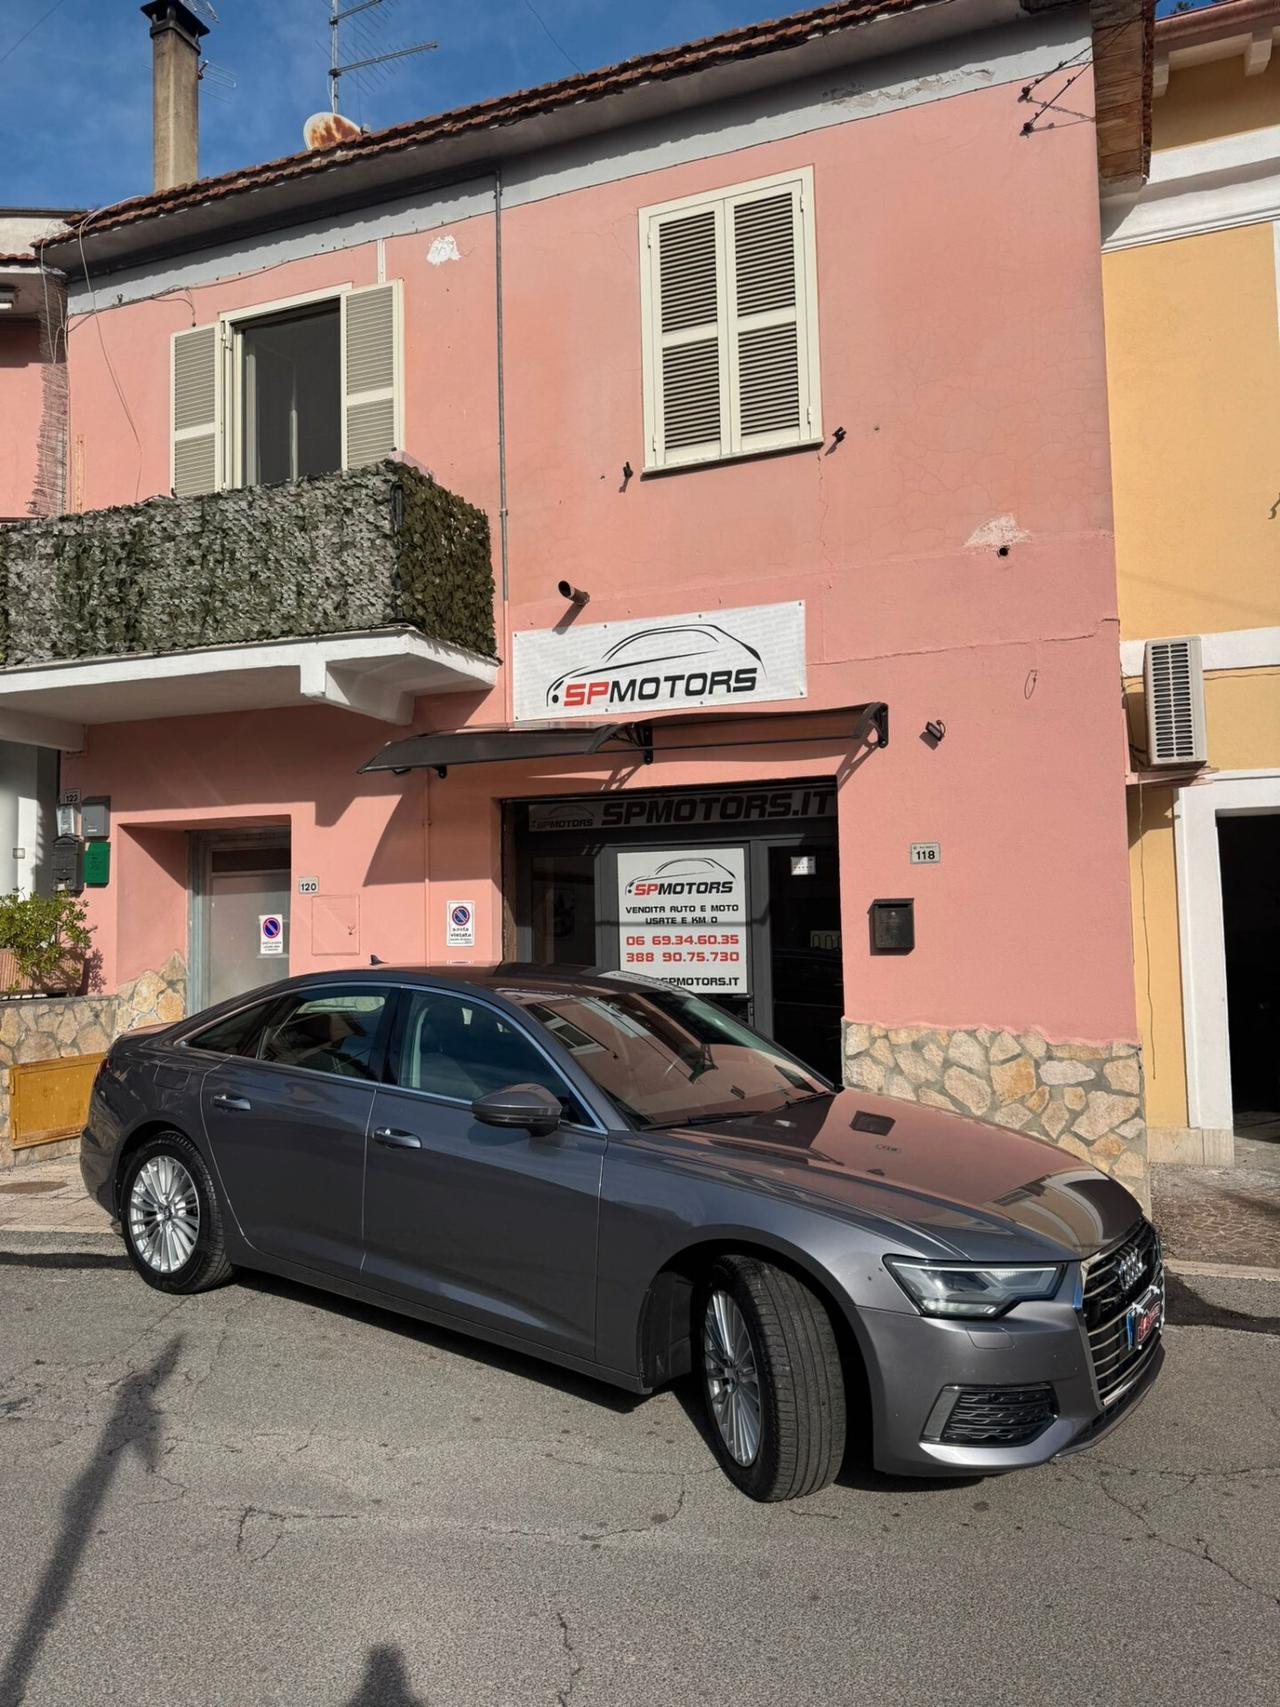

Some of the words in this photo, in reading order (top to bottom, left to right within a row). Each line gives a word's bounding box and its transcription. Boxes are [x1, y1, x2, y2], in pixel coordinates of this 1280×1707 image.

[564, 668, 757, 707] SPMOTORS
[602, 790, 835, 826] SPMOTORS.IT
[916, 850, 936, 860] 118
[301, 883, 317, 891] 120
[634, 881, 734, 896] SPMOTORS
[625, 906, 666, 914] VENDITA
[670, 905, 696, 913] AUTO
[711, 904, 739, 912] MOTO
[645, 917, 677, 925] USATE
[691, 916, 706, 924] KM
[626, 936, 645, 945] 06
[652, 934, 739, 945] 69.34.60.35
[626, 952, 655, 962] 388
[662, 951, 740, 962] 90.75.730
